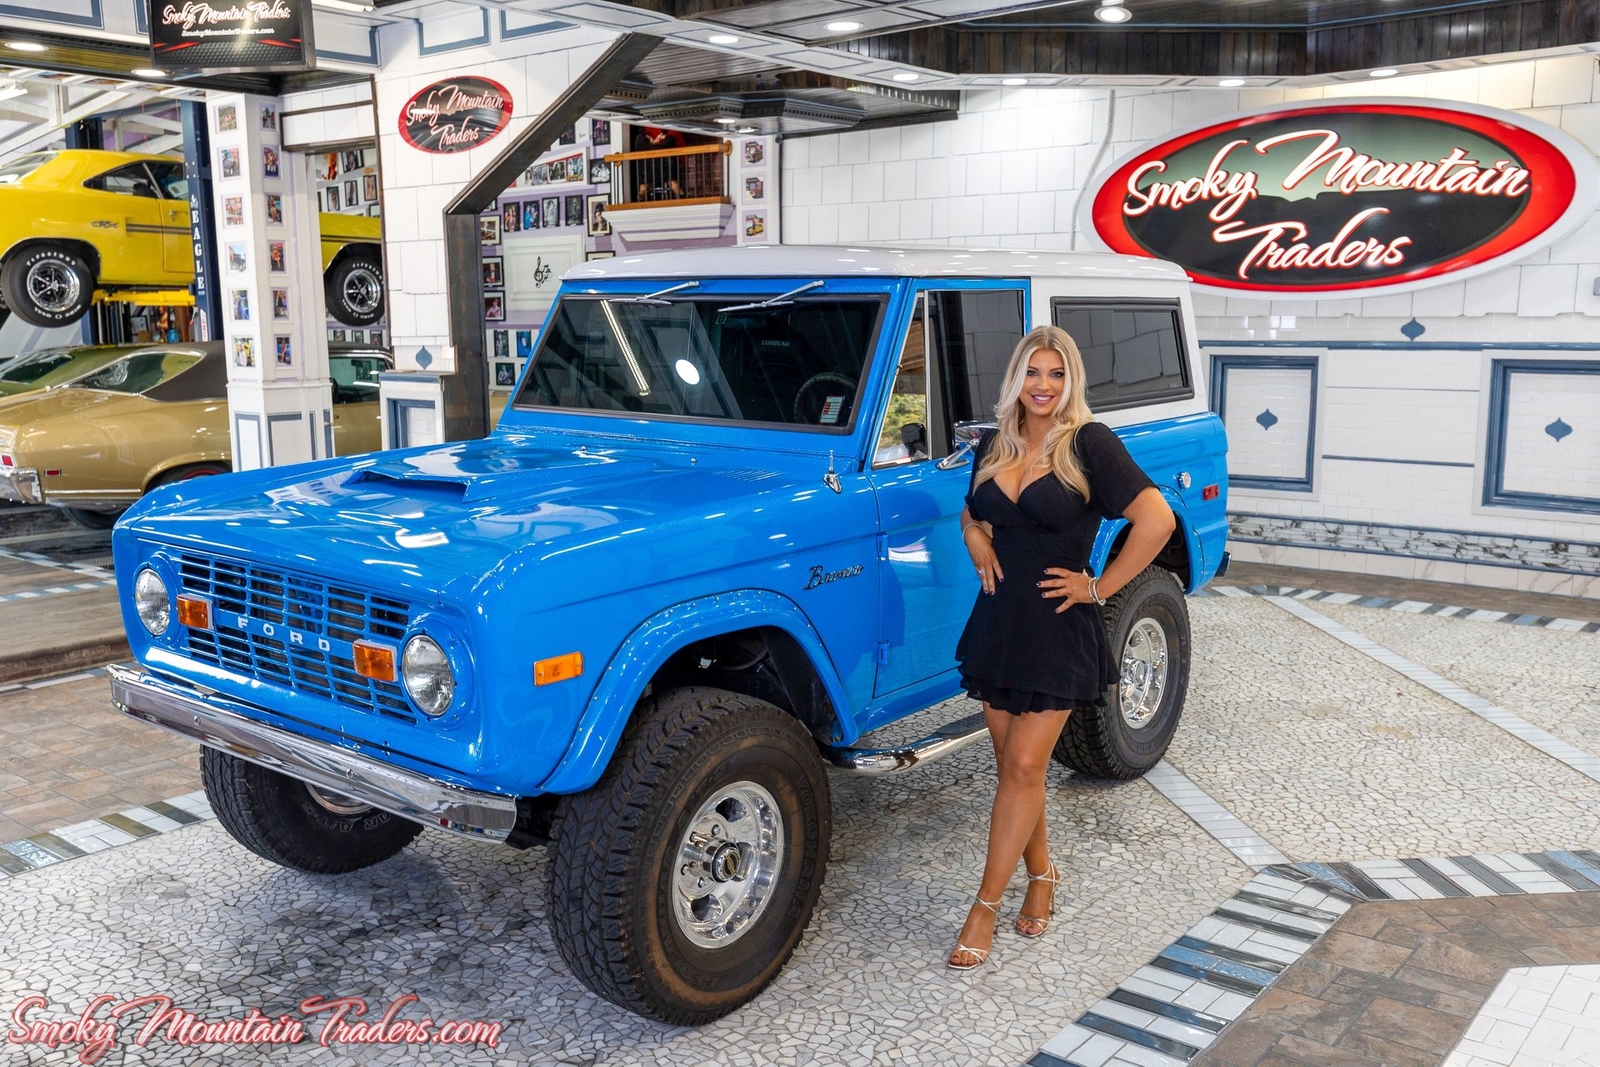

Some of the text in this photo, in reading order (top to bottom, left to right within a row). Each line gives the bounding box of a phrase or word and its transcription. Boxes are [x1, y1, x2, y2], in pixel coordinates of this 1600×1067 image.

[162, 0, 291, 29] Smoky Mountain Traders
[438, 84, 504, 111] Mountain
[430, 115, 480, 151] Traders
[1123, 129, 1531, 222] Smoky Mountain
[191, 210, 206, 290] EAGLE
[1212, 207, 1412, 280] Traders
[804, 563, 865, 590] Bronco
[237, 615, 332, 653] FORD
